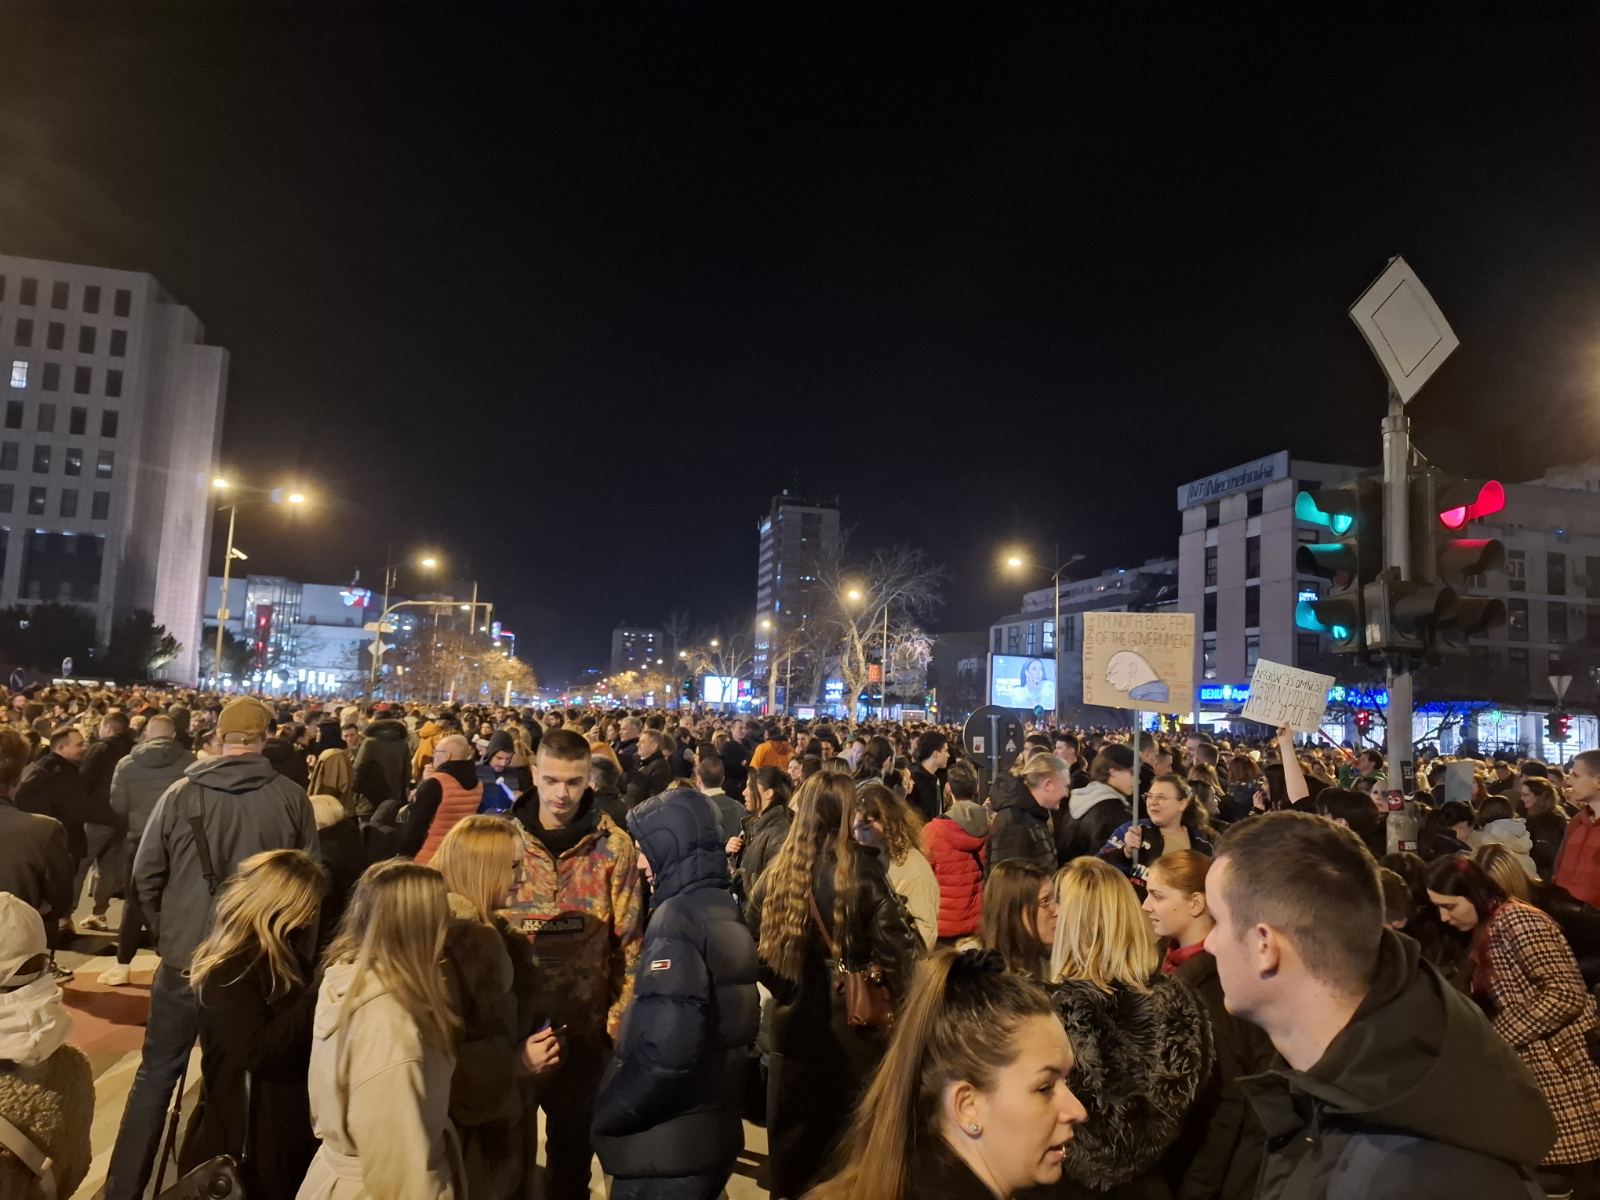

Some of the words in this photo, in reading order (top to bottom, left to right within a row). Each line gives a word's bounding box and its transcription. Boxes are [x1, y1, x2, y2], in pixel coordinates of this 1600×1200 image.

[1113, 614, 1133, 629] NOT
[1095, 630, 1109, 646] OF
[1110, 631, 1127, 647] THE
[1201, 688, 1223, 700] BENU
